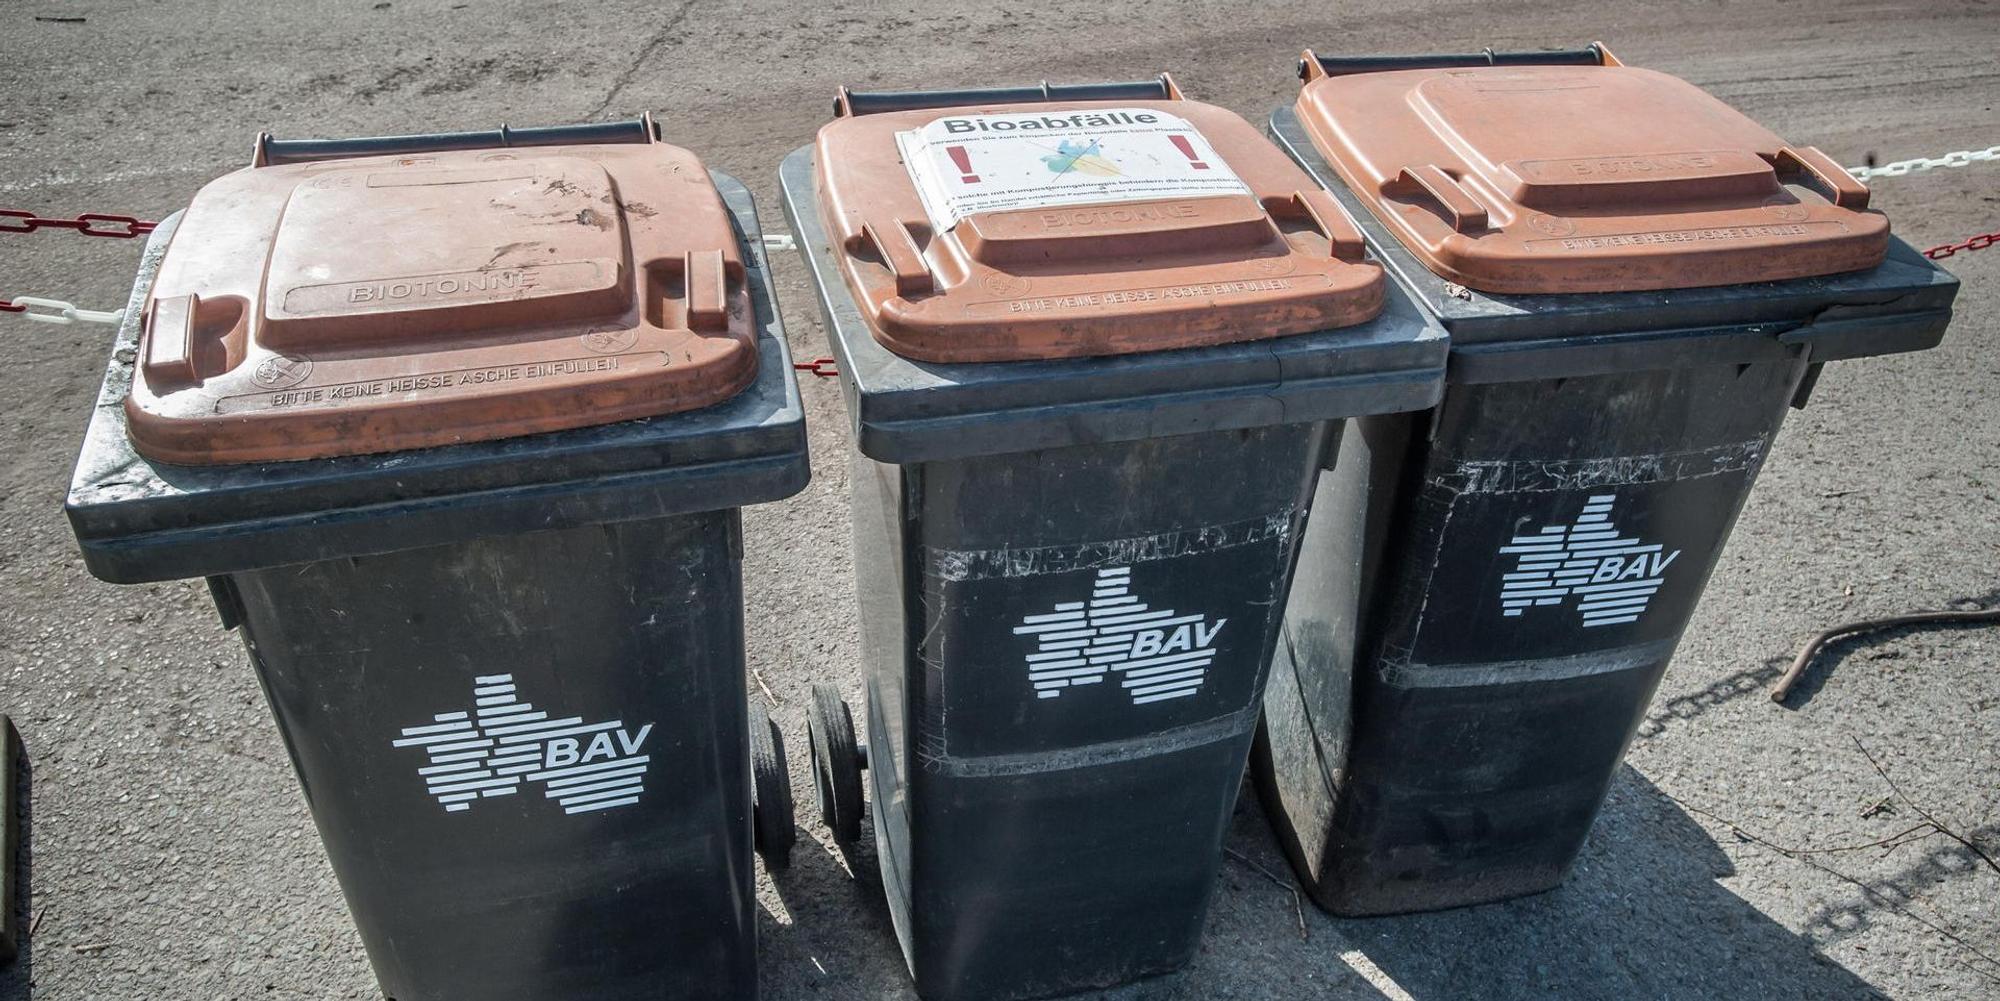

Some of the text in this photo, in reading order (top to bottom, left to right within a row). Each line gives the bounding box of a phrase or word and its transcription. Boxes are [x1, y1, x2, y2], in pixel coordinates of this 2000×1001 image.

[943, 112, 1158, 134] Bioabfälle
[1570, 156, 1713, 175] BIOTONNE
[1040, 204, 1200, 228] BIOTONNE
[350, 271, 540, 303] BIOTONNE
[1009, 299, 1052, 313] BITTE
[1056, 295, 1100, 309] KEINE
[1103, 290, 1158, 305] HEISSE
[1161, 284, 1210, 299] ASCHE
[272, 389, 323, 407] BITTE
[329, 382, 382, 400] KEINE
[388, 375, 453, 393] HEISSE
[459, 367, 520, 386] ASCHE
[1591, 550, 1681, 583] BAV
[1129, 618, 1227, 659] BAV
[545, 723, 654, 769] BAV
